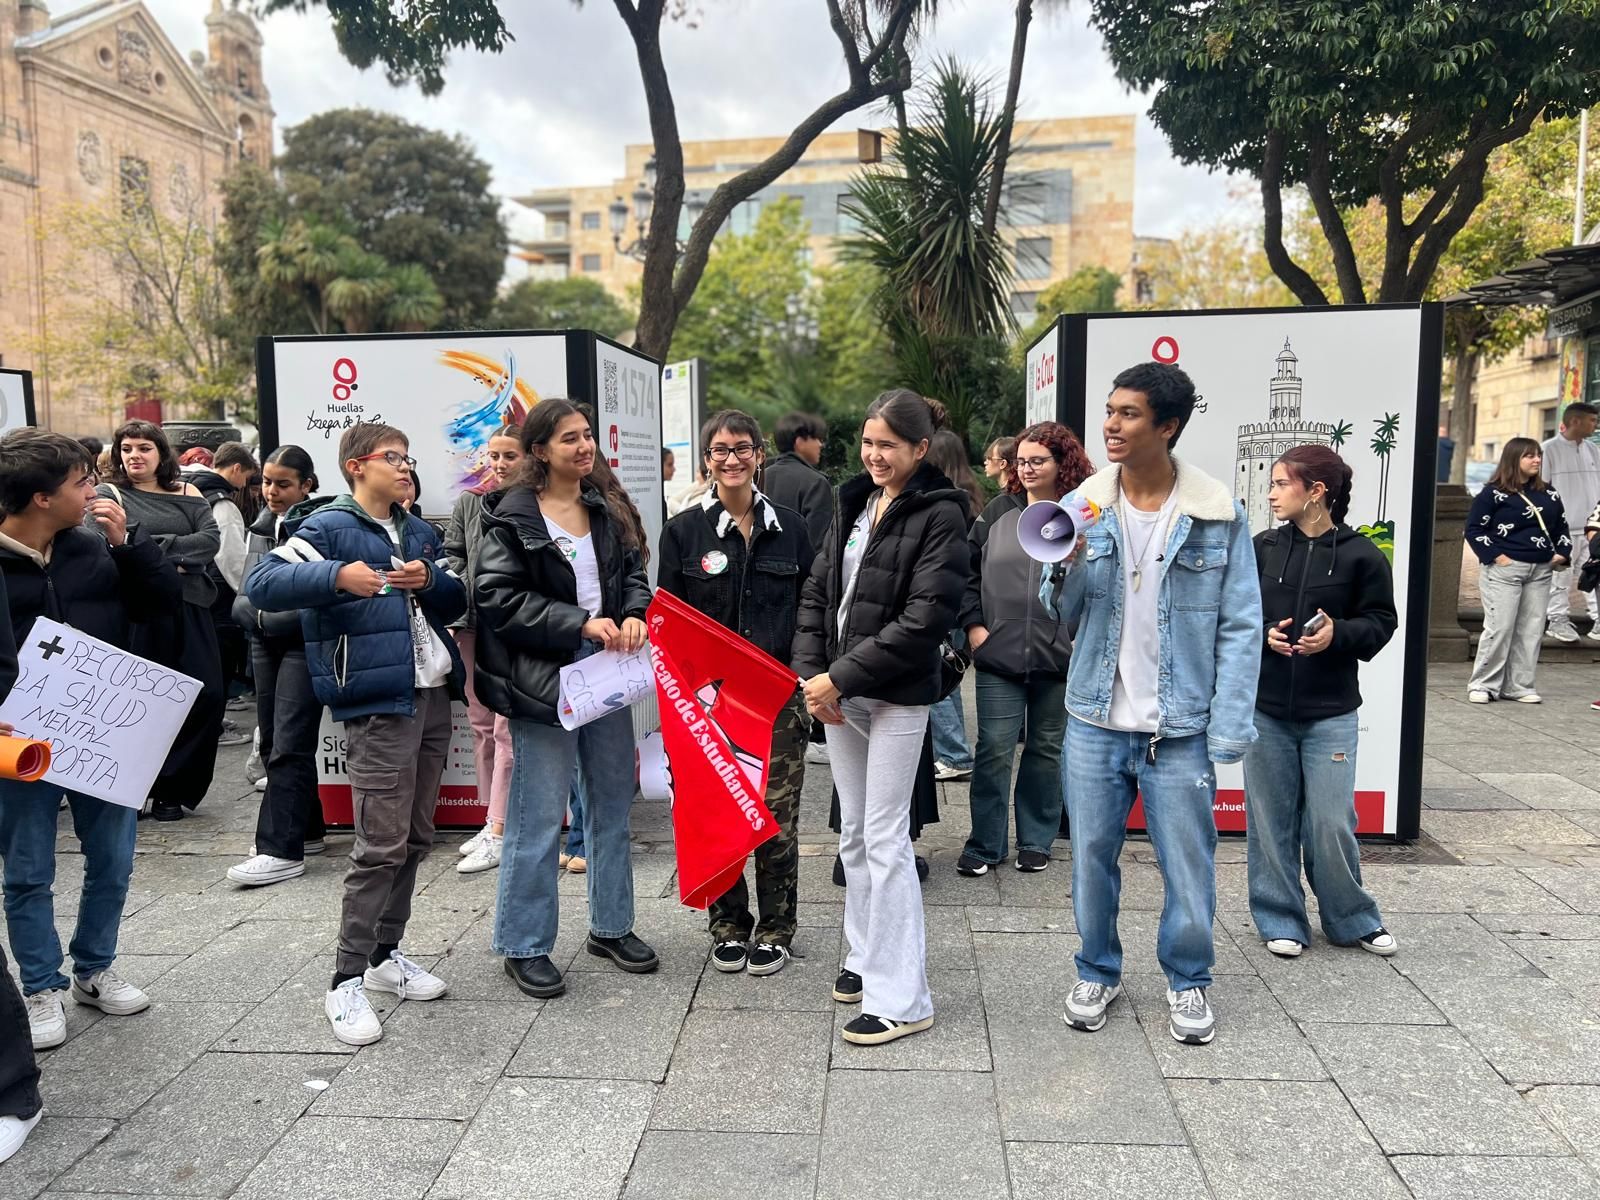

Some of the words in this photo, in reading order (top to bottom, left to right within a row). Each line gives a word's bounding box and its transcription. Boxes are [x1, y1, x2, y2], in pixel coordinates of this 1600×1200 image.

[621, 366, 655, 419] 1574
[1041, 352, 1055, 388] Cruz
[327, 403, 364, 413] Huellas
[61, 640, 195, 703] RECURSOS
[20, 705, 111, 748] MENTAL
[58, 681, 147, 728] SALUD
[673, 697, 697, 726] de
[688, 717, 766, 832] Estudiantes
